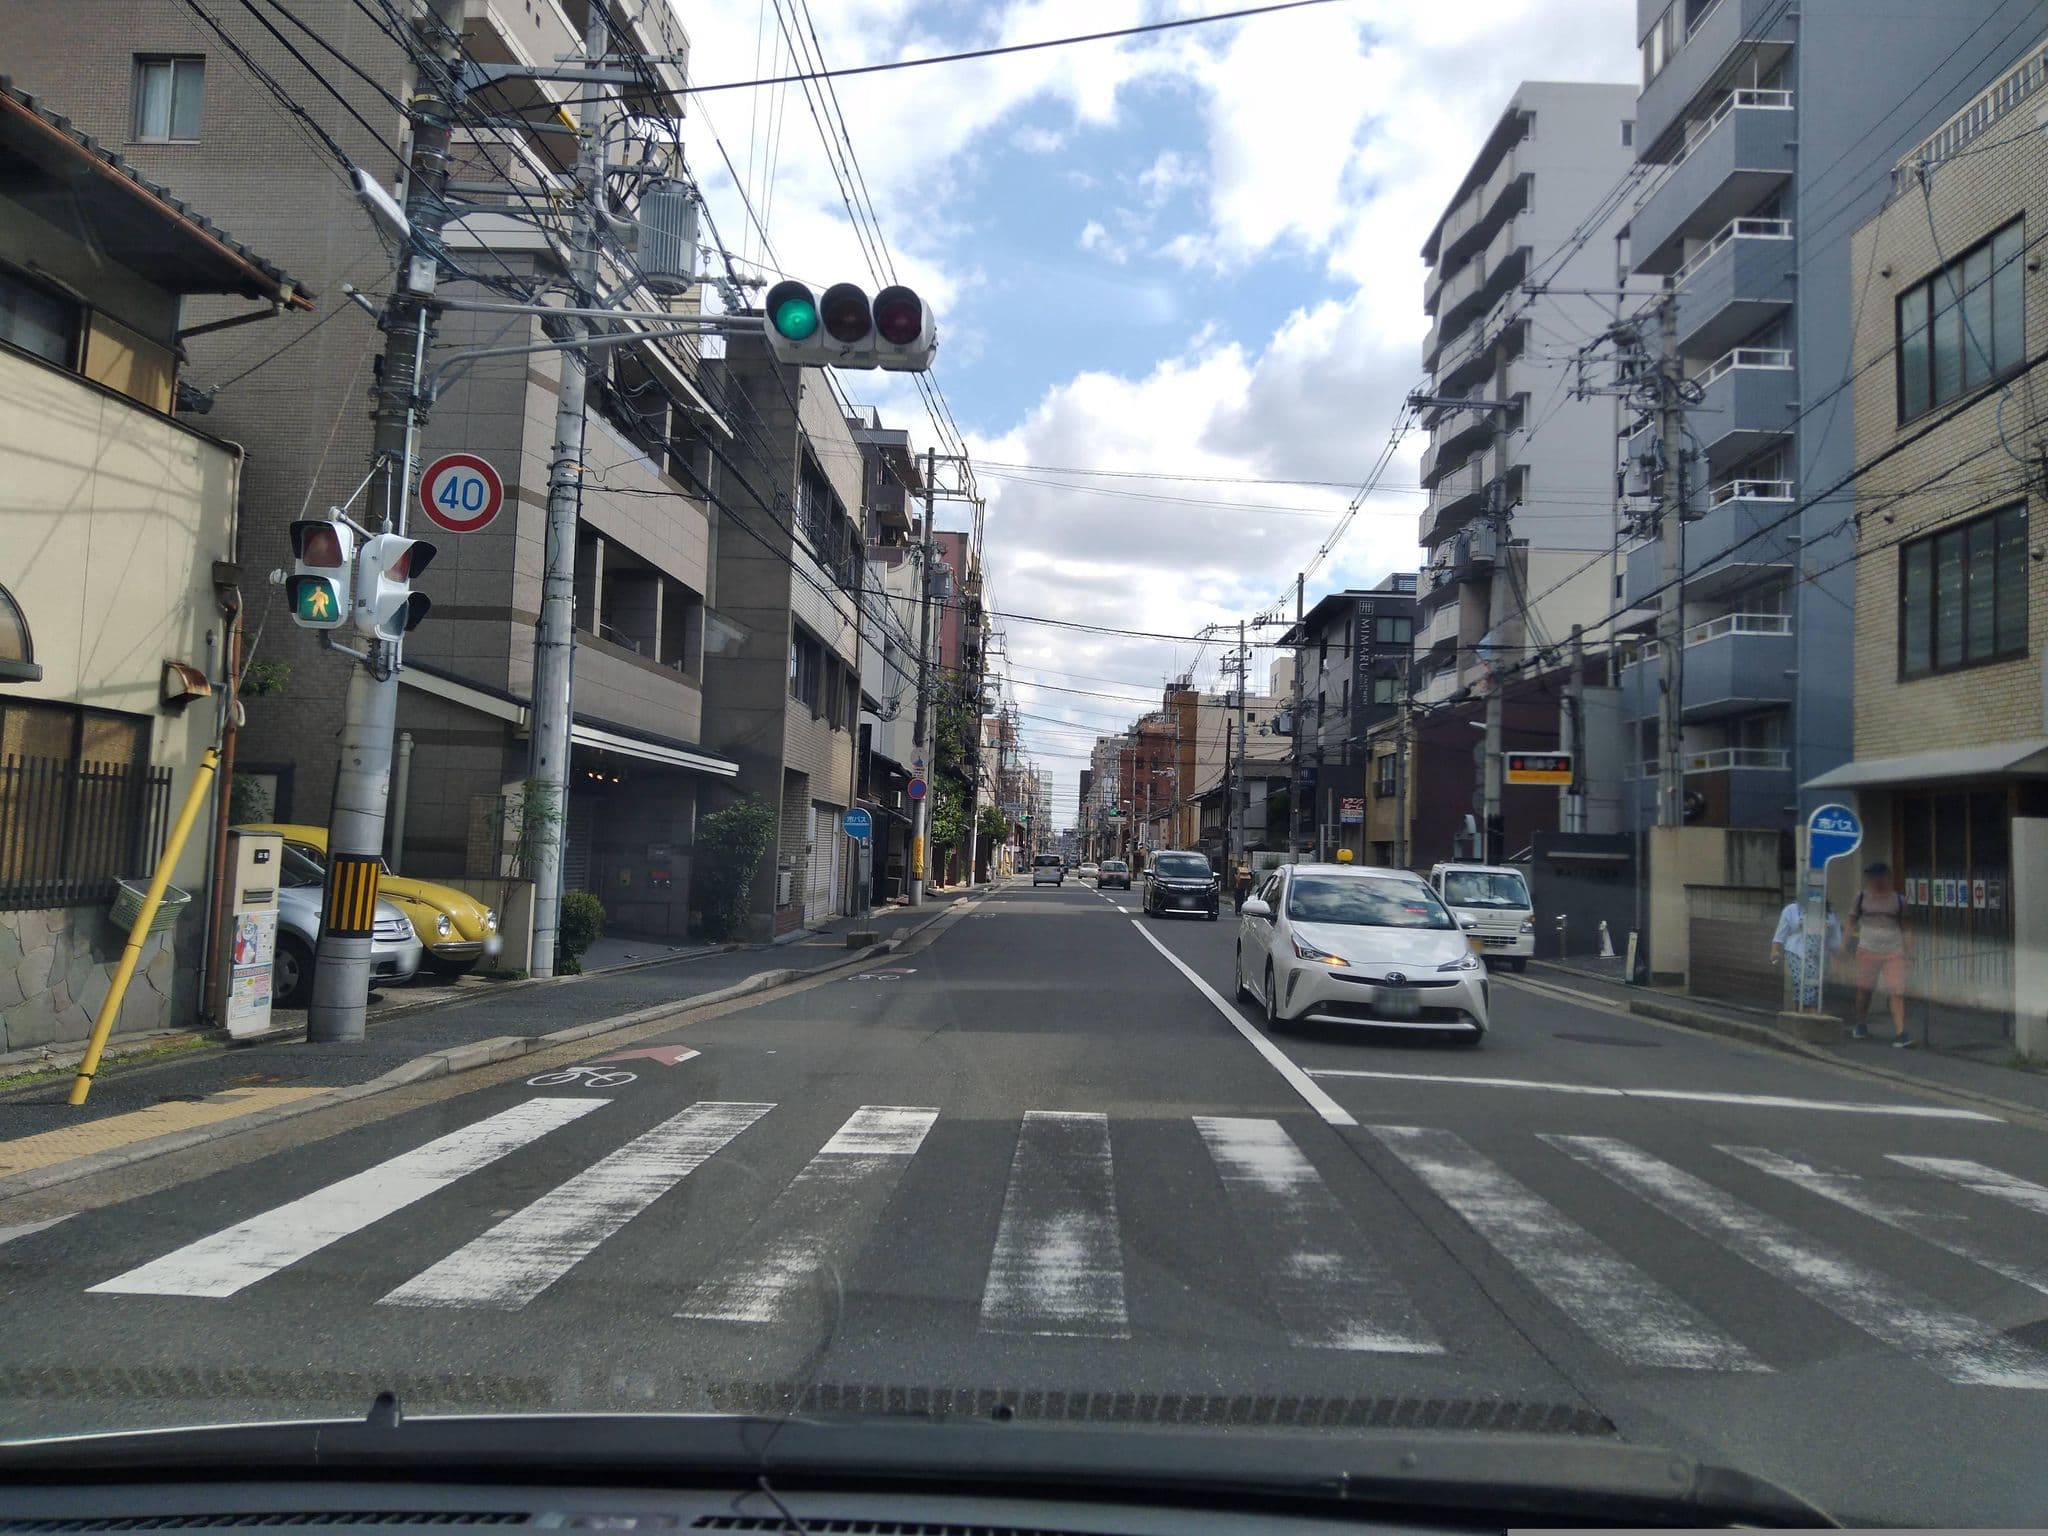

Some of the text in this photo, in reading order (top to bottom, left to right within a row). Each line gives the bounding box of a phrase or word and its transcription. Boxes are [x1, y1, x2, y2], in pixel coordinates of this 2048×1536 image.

[438, 476, 484, 511] 40
[1359, 619, 1370, 671] MIMARU
[1817, 818, 1853, 832] 市バス
